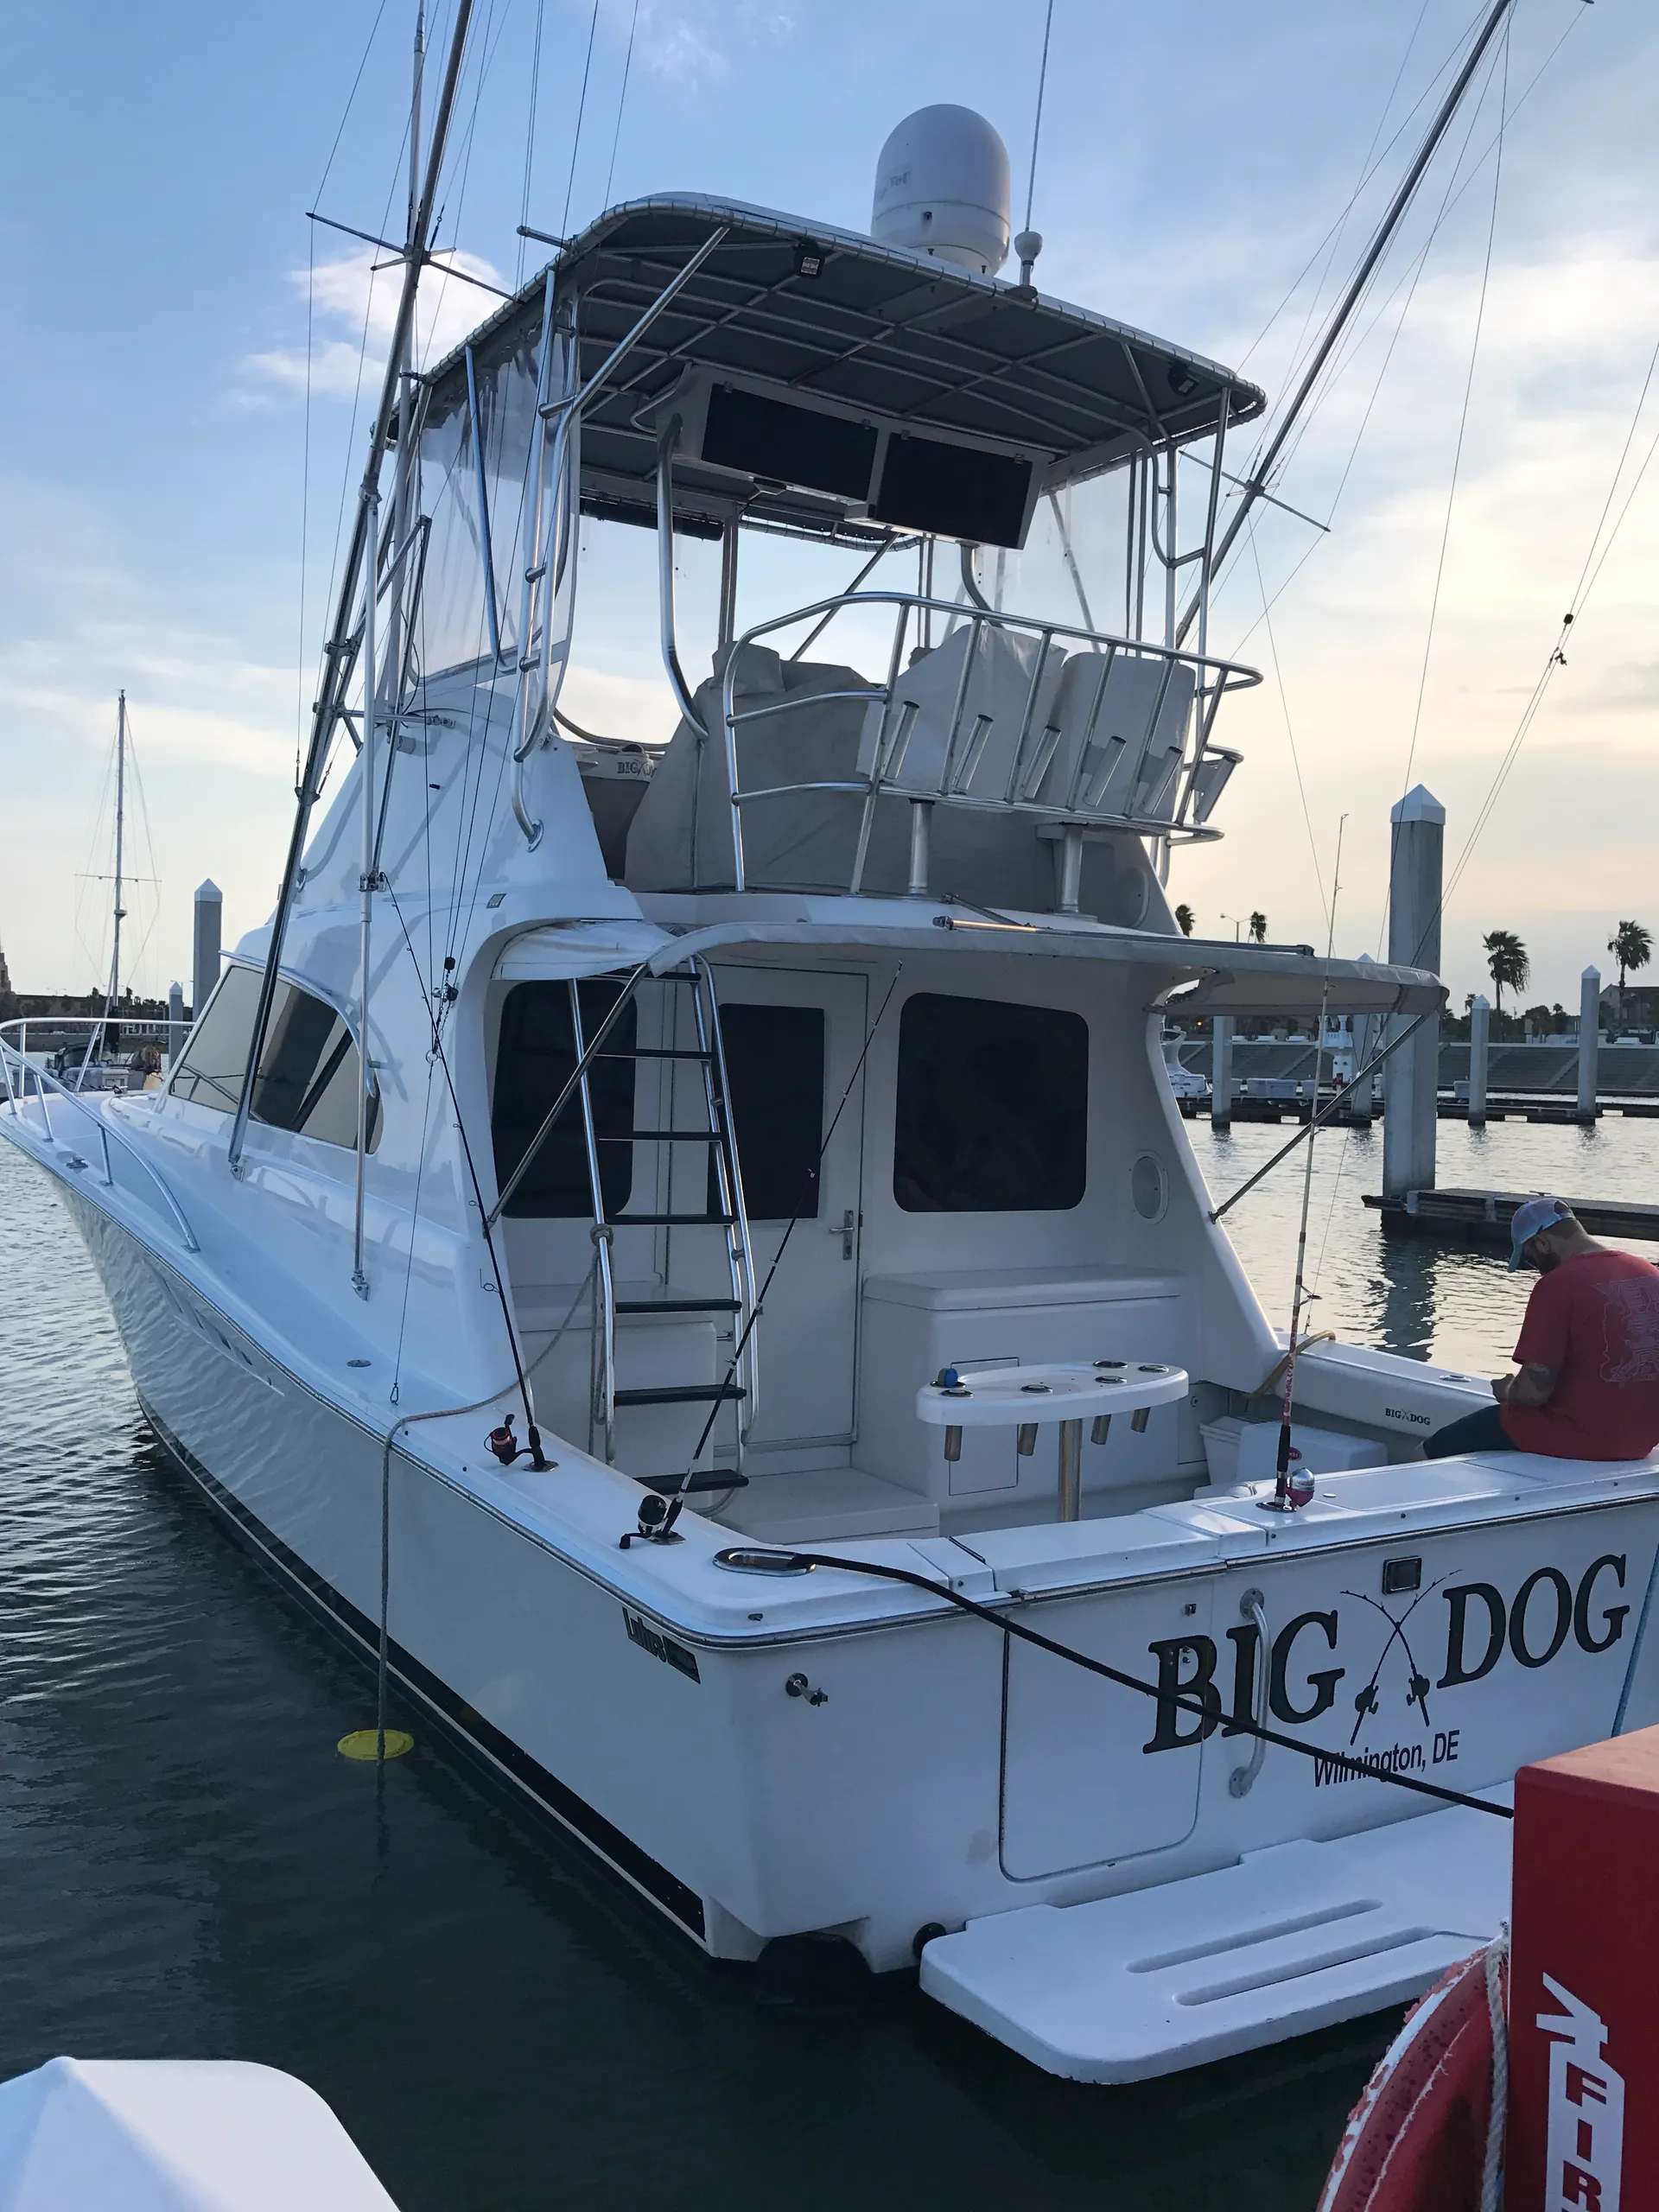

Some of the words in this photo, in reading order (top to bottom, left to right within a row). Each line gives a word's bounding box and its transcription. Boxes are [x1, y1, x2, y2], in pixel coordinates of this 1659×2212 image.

[617, 761, 639, 774] BIG
[1385, 1408, 1402, 1419] BIG
[1410, 1414, 1431, 1426] DOG
[1141, 1609, 1345, 1754] BIG
[1436, 1554, 1630, 1689] DOG
[1432, 1729, 1460, 1764] DE
[1560, 2061, 1607, 2212] FIR
